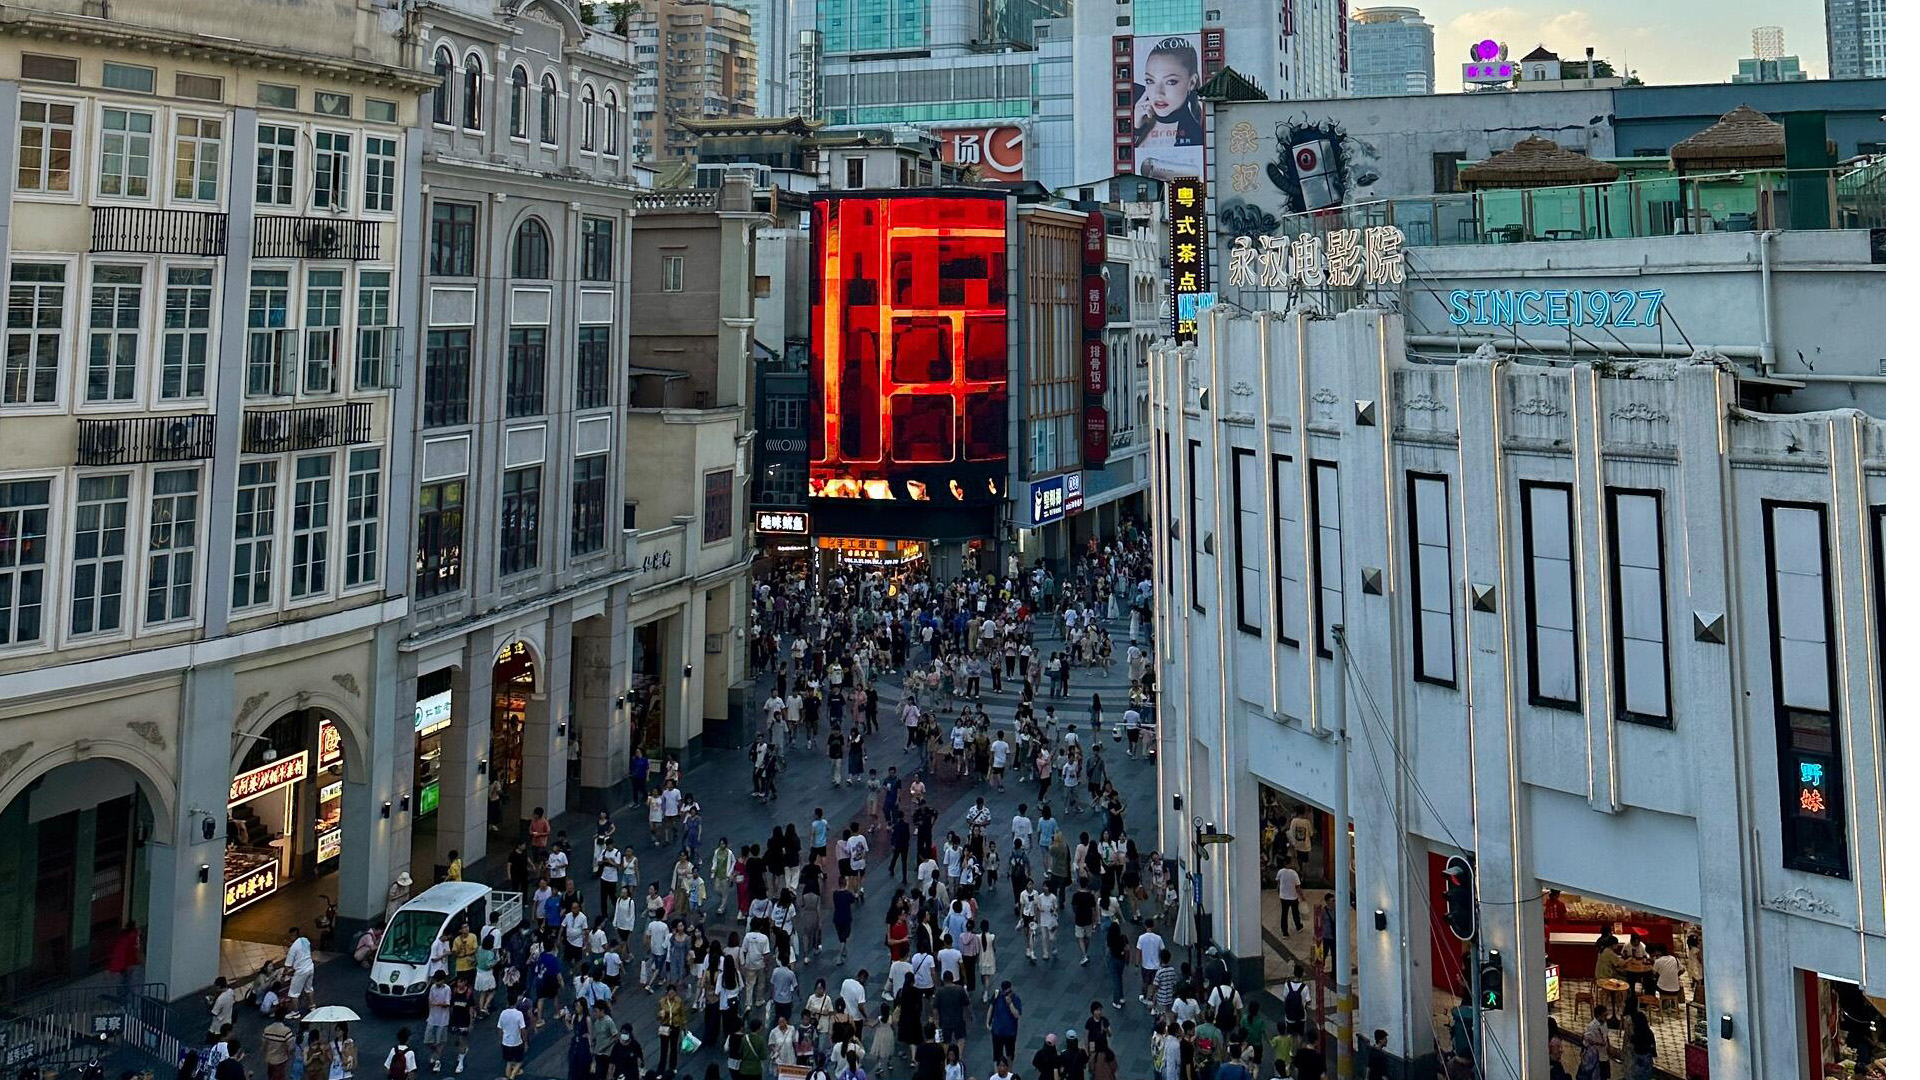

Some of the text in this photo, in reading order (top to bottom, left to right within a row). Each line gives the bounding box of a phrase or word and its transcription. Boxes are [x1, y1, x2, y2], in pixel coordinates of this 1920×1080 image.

[1176, 187, 1197, 291] 粤式茶点
[1229, 226, 1405, 287] 永汉电影院
[1448, 288, 1665, 328] SINCE1927
[1090, 345, 1101, 383] 排骨饭
[94, 1016, 121, 1031] 警察
